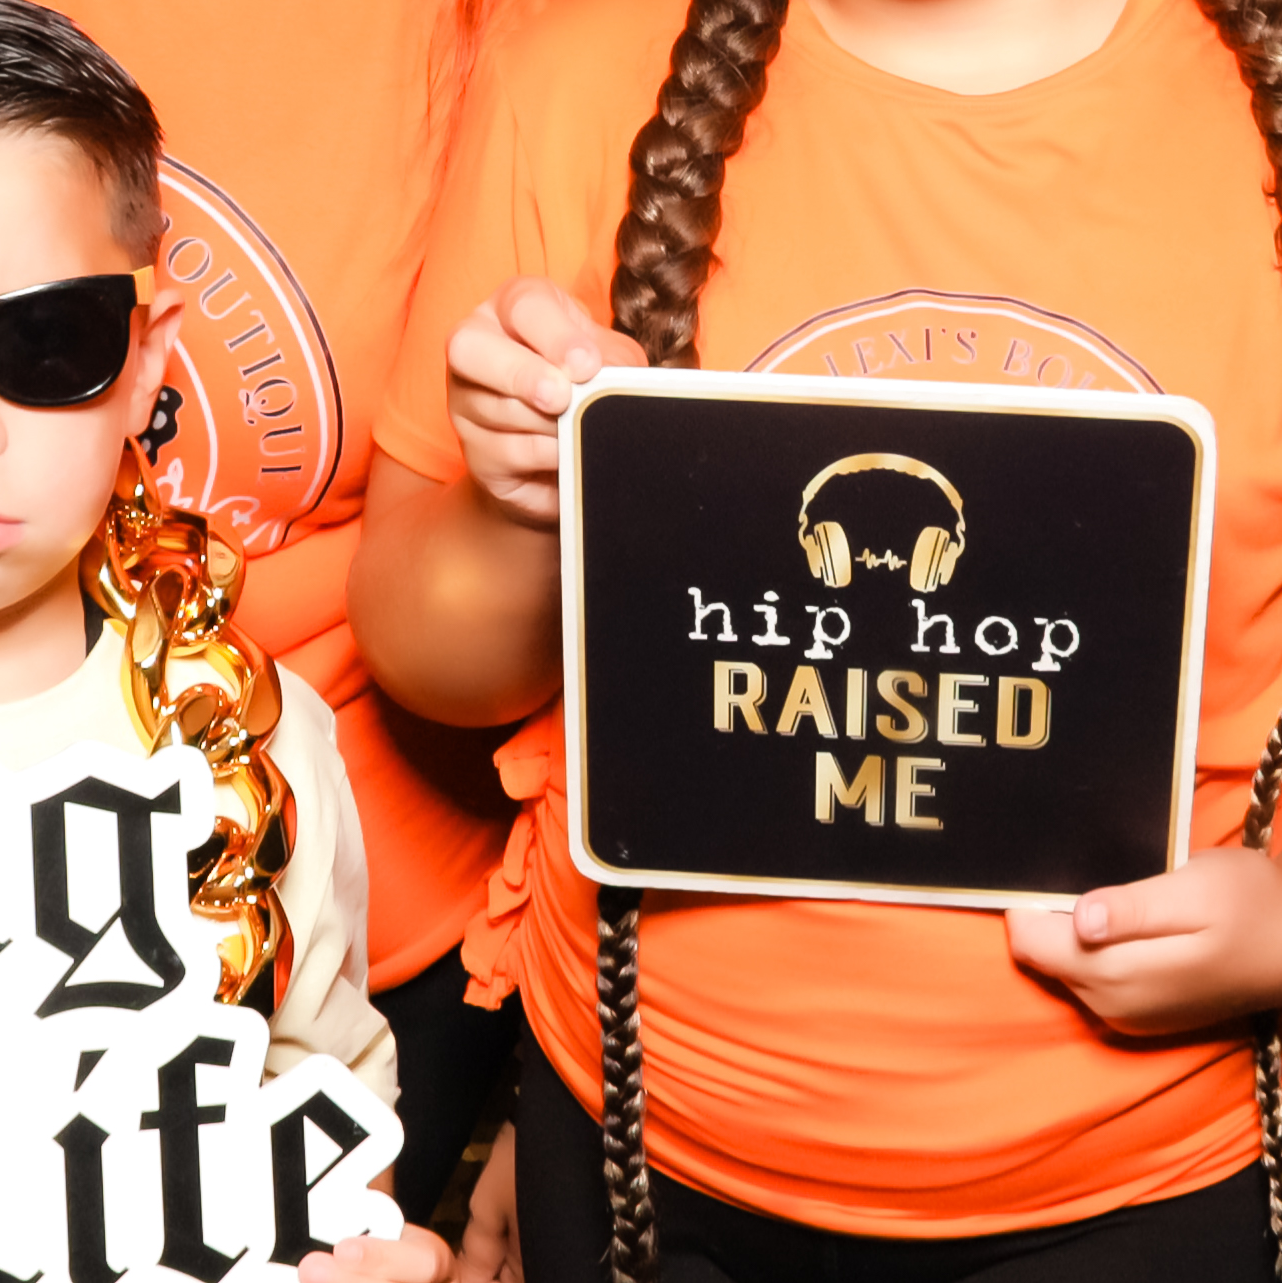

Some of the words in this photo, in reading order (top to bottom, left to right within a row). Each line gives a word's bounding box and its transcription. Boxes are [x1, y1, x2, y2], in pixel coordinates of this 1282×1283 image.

[160, 212, 305, 486] OUTIQUE
[688, 587, 851, 659] hip
[911, 599, 1080, 672] hop
[714, 660, 1052, 749] RAISED
[815, 752, 946, 830] ME
